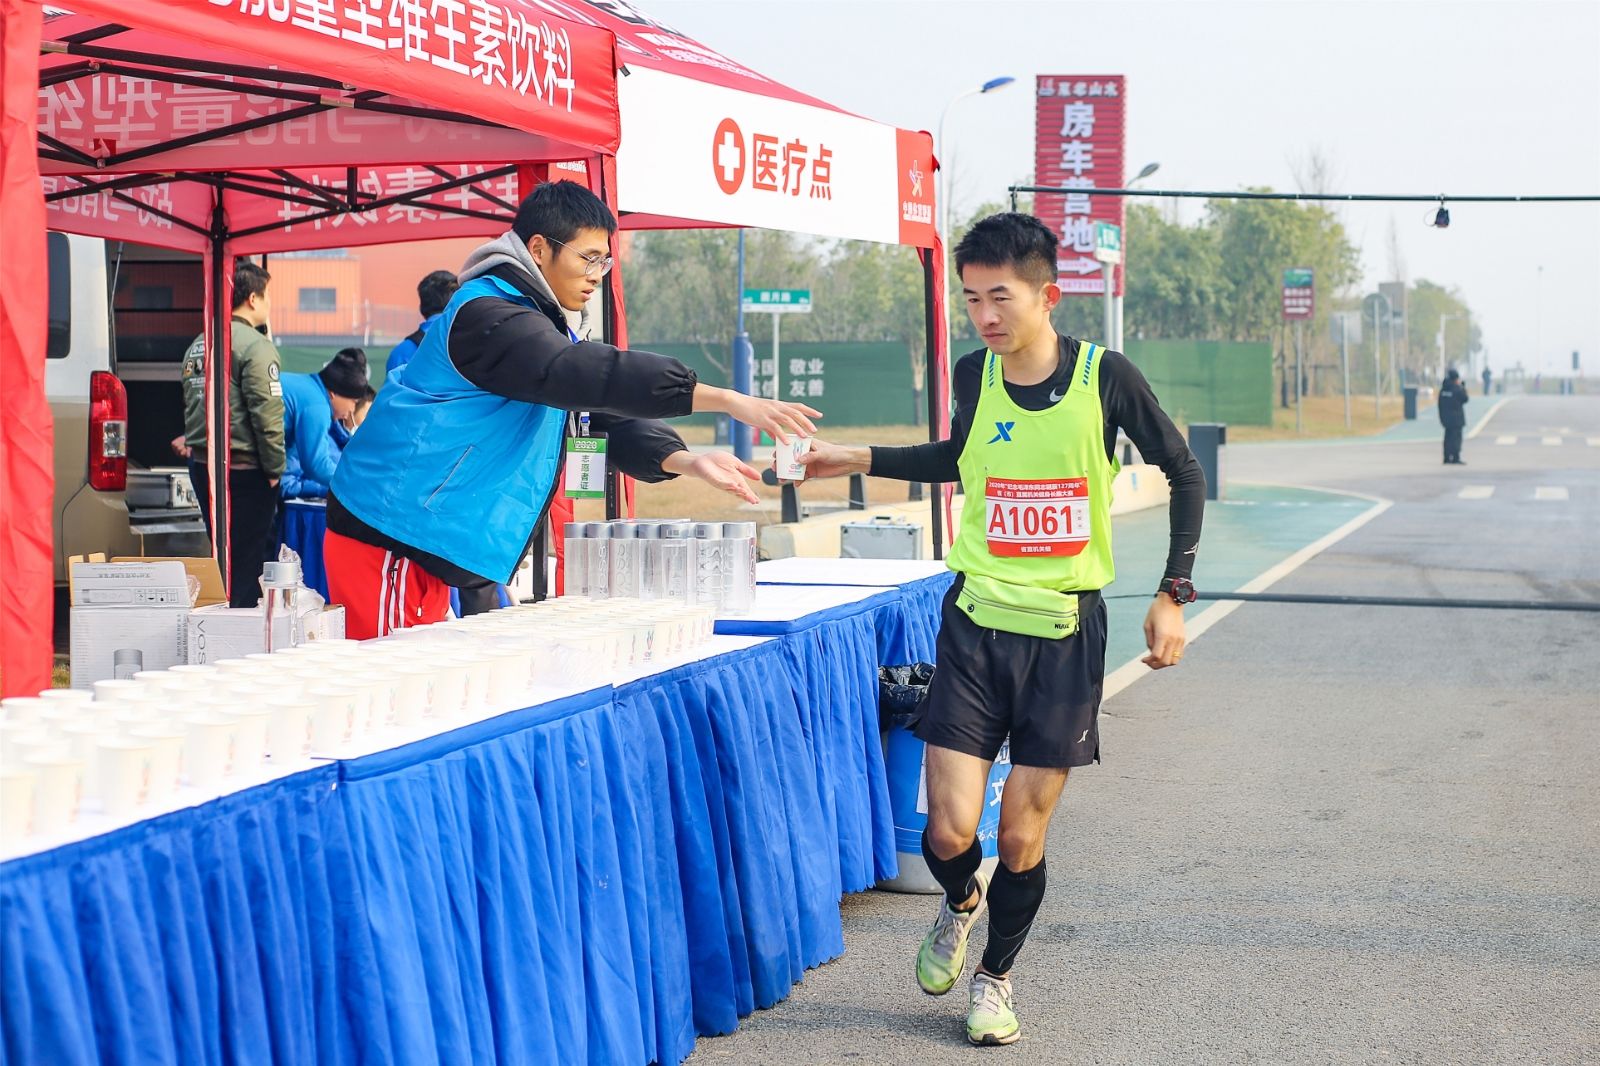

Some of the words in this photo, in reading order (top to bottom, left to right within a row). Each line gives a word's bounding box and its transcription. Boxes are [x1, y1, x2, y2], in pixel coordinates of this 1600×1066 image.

[752, 132, 833, 201] 医疗点
[1060, 101, 1096, 254] 房车营地
[789, 358, 825, 376] 敬业
[789, 379, 825, 397] 友善
[575, 440, 598, 449] 2020
[988, 503, 1073, 536] A1061
